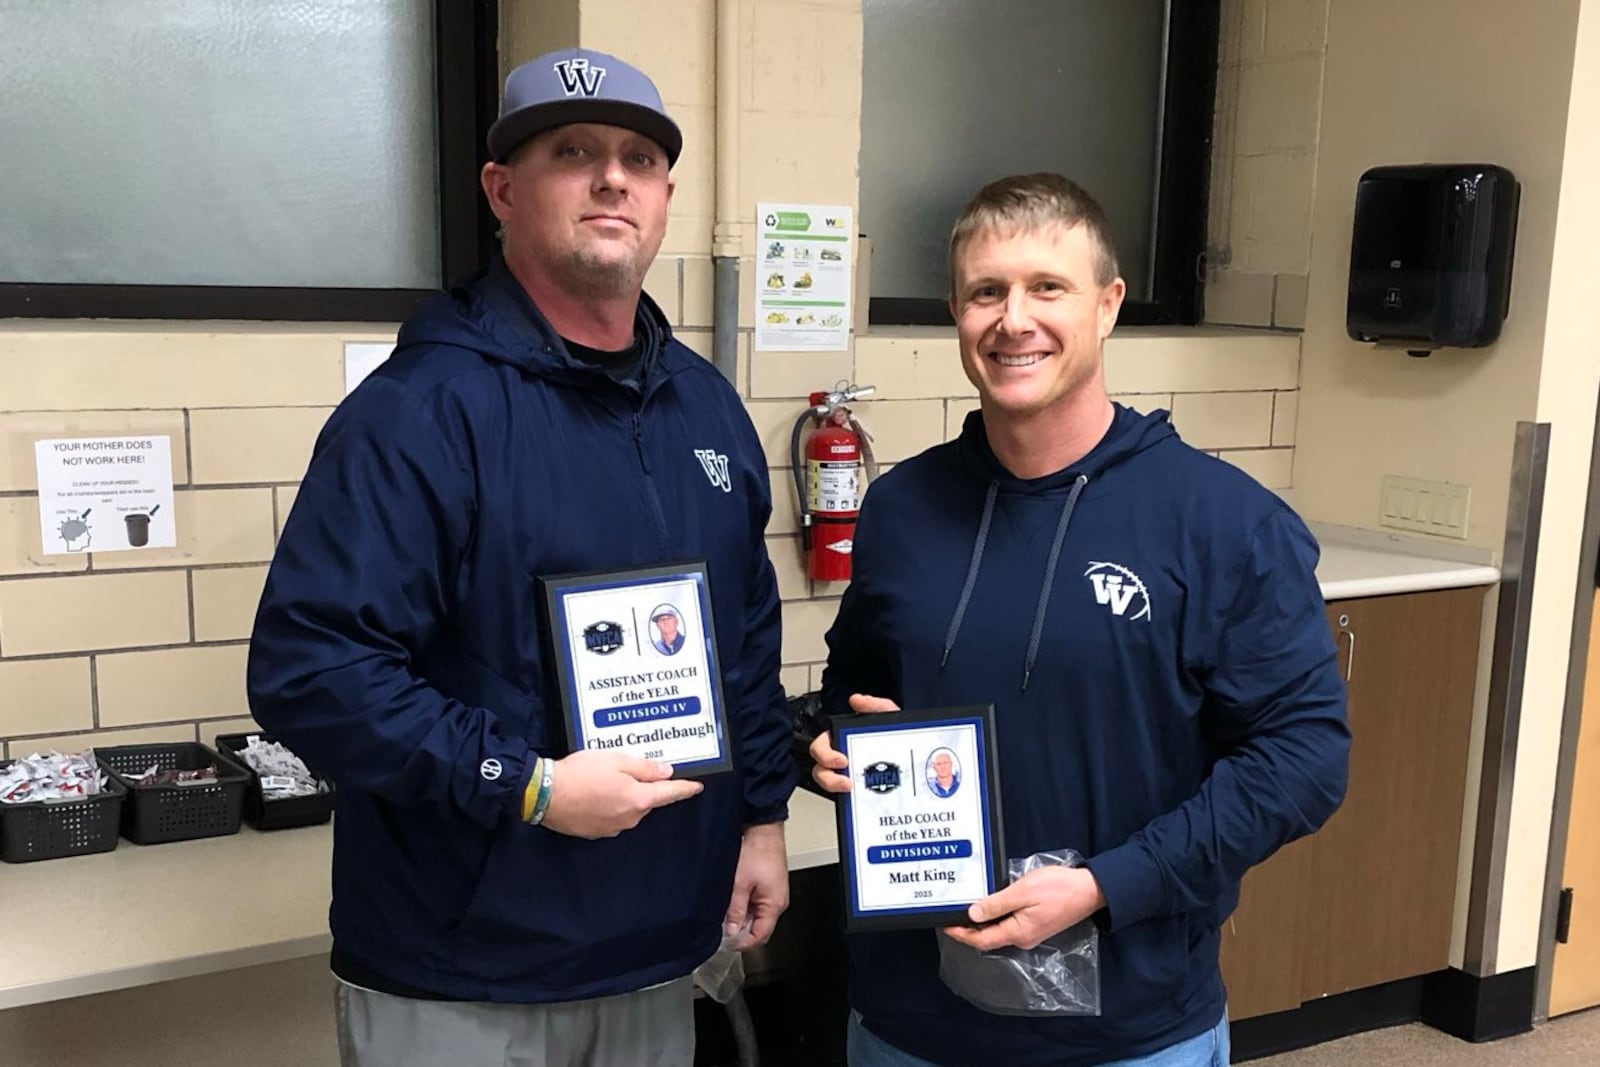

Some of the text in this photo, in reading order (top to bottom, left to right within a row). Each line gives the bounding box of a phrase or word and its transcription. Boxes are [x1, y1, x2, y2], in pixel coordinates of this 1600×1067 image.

[54, 440, 152, 452] YOUR MOTHER DOES
[62, 456, 145, 466] NOT WORK HERE!
[588, 666, 698, 691] ASSISTANT COACH
[612, 685, 680, 704] of the YEAR
[607, 702, 687, 722] DIVISION IV
[587, 722, 714, 750] Chad Cradlebaugh
[644, 750, 664, 759] 2025
[879, 811, 955, 827] HEAD COACH
[885, 827, 952, 841] of the YEAR
[880, 844, 958, 859] DIVISION IV
[889, 868, 956, 884] Matt King
[914, 890, 933, 898] 2025
